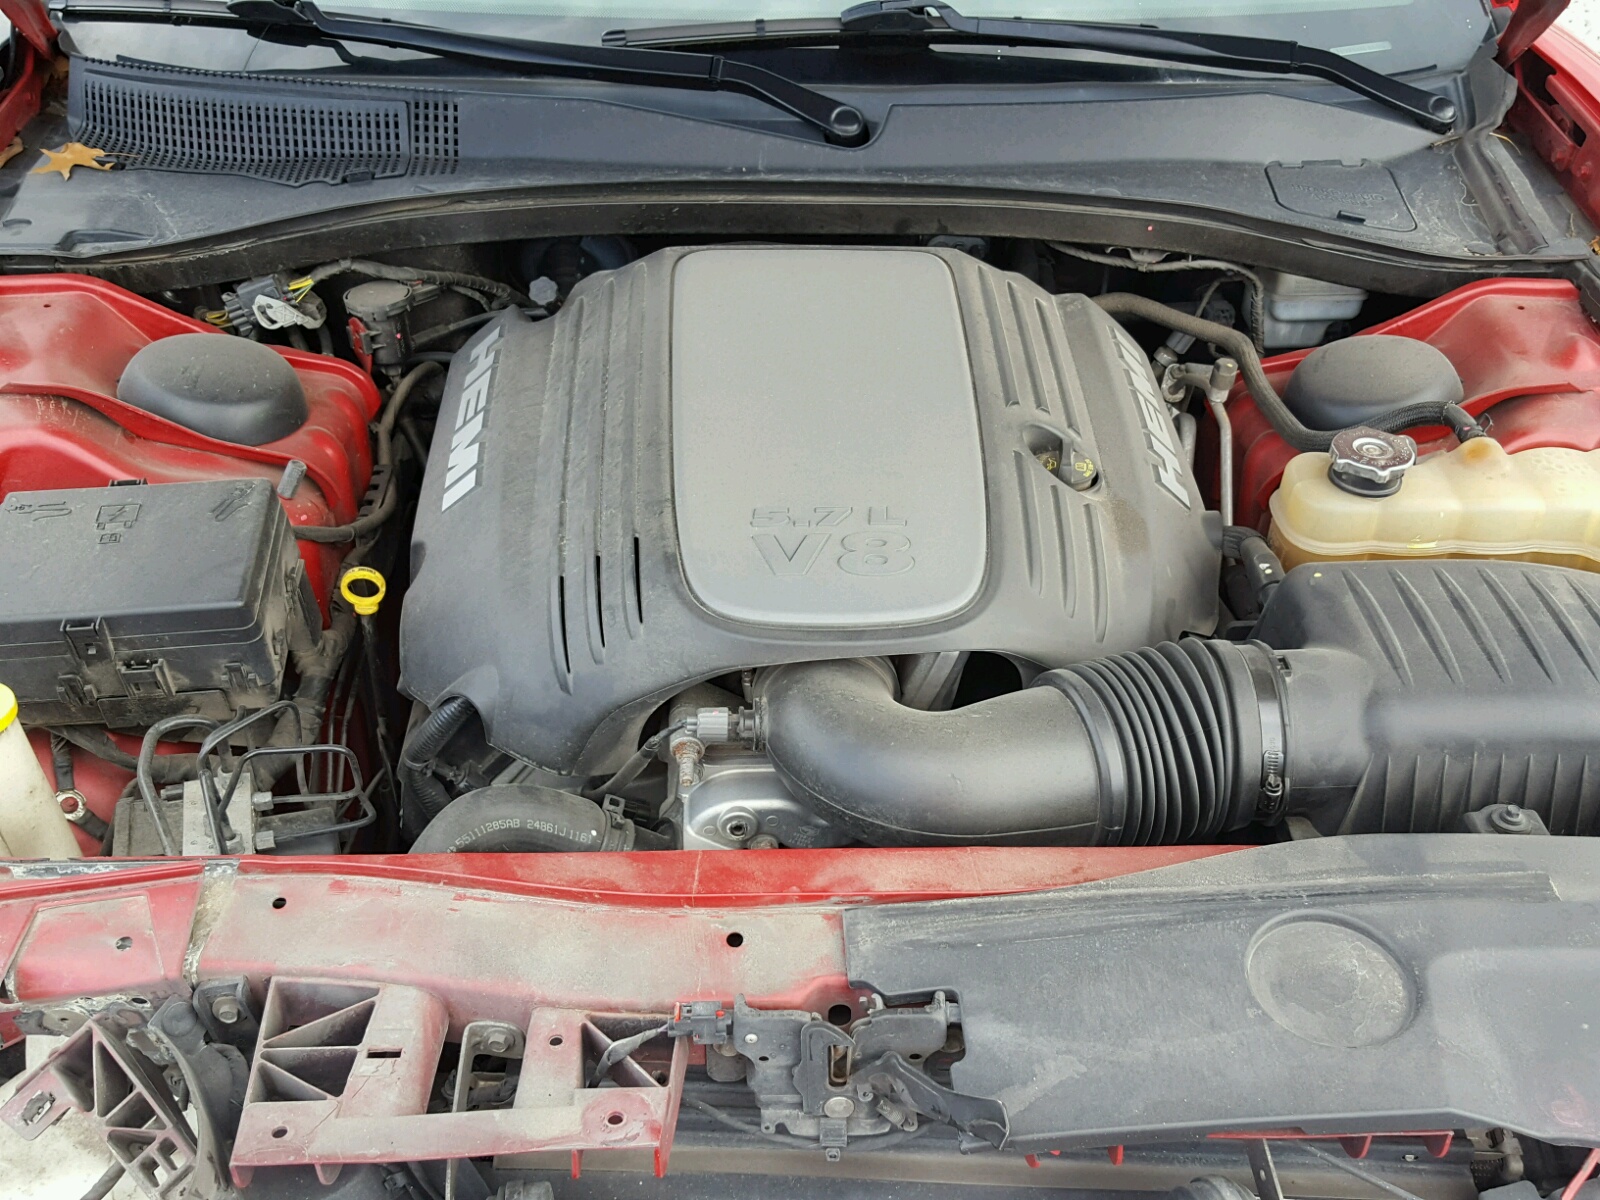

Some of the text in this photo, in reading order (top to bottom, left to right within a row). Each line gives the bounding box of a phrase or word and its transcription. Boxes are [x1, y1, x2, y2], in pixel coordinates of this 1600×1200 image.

[441, 326, 501, 512] HEMI
[1111, 326, 1191, 511] HEMI
[750, 531, 916, 577] V8
[454, 818, 521, 849] 55111285AB
